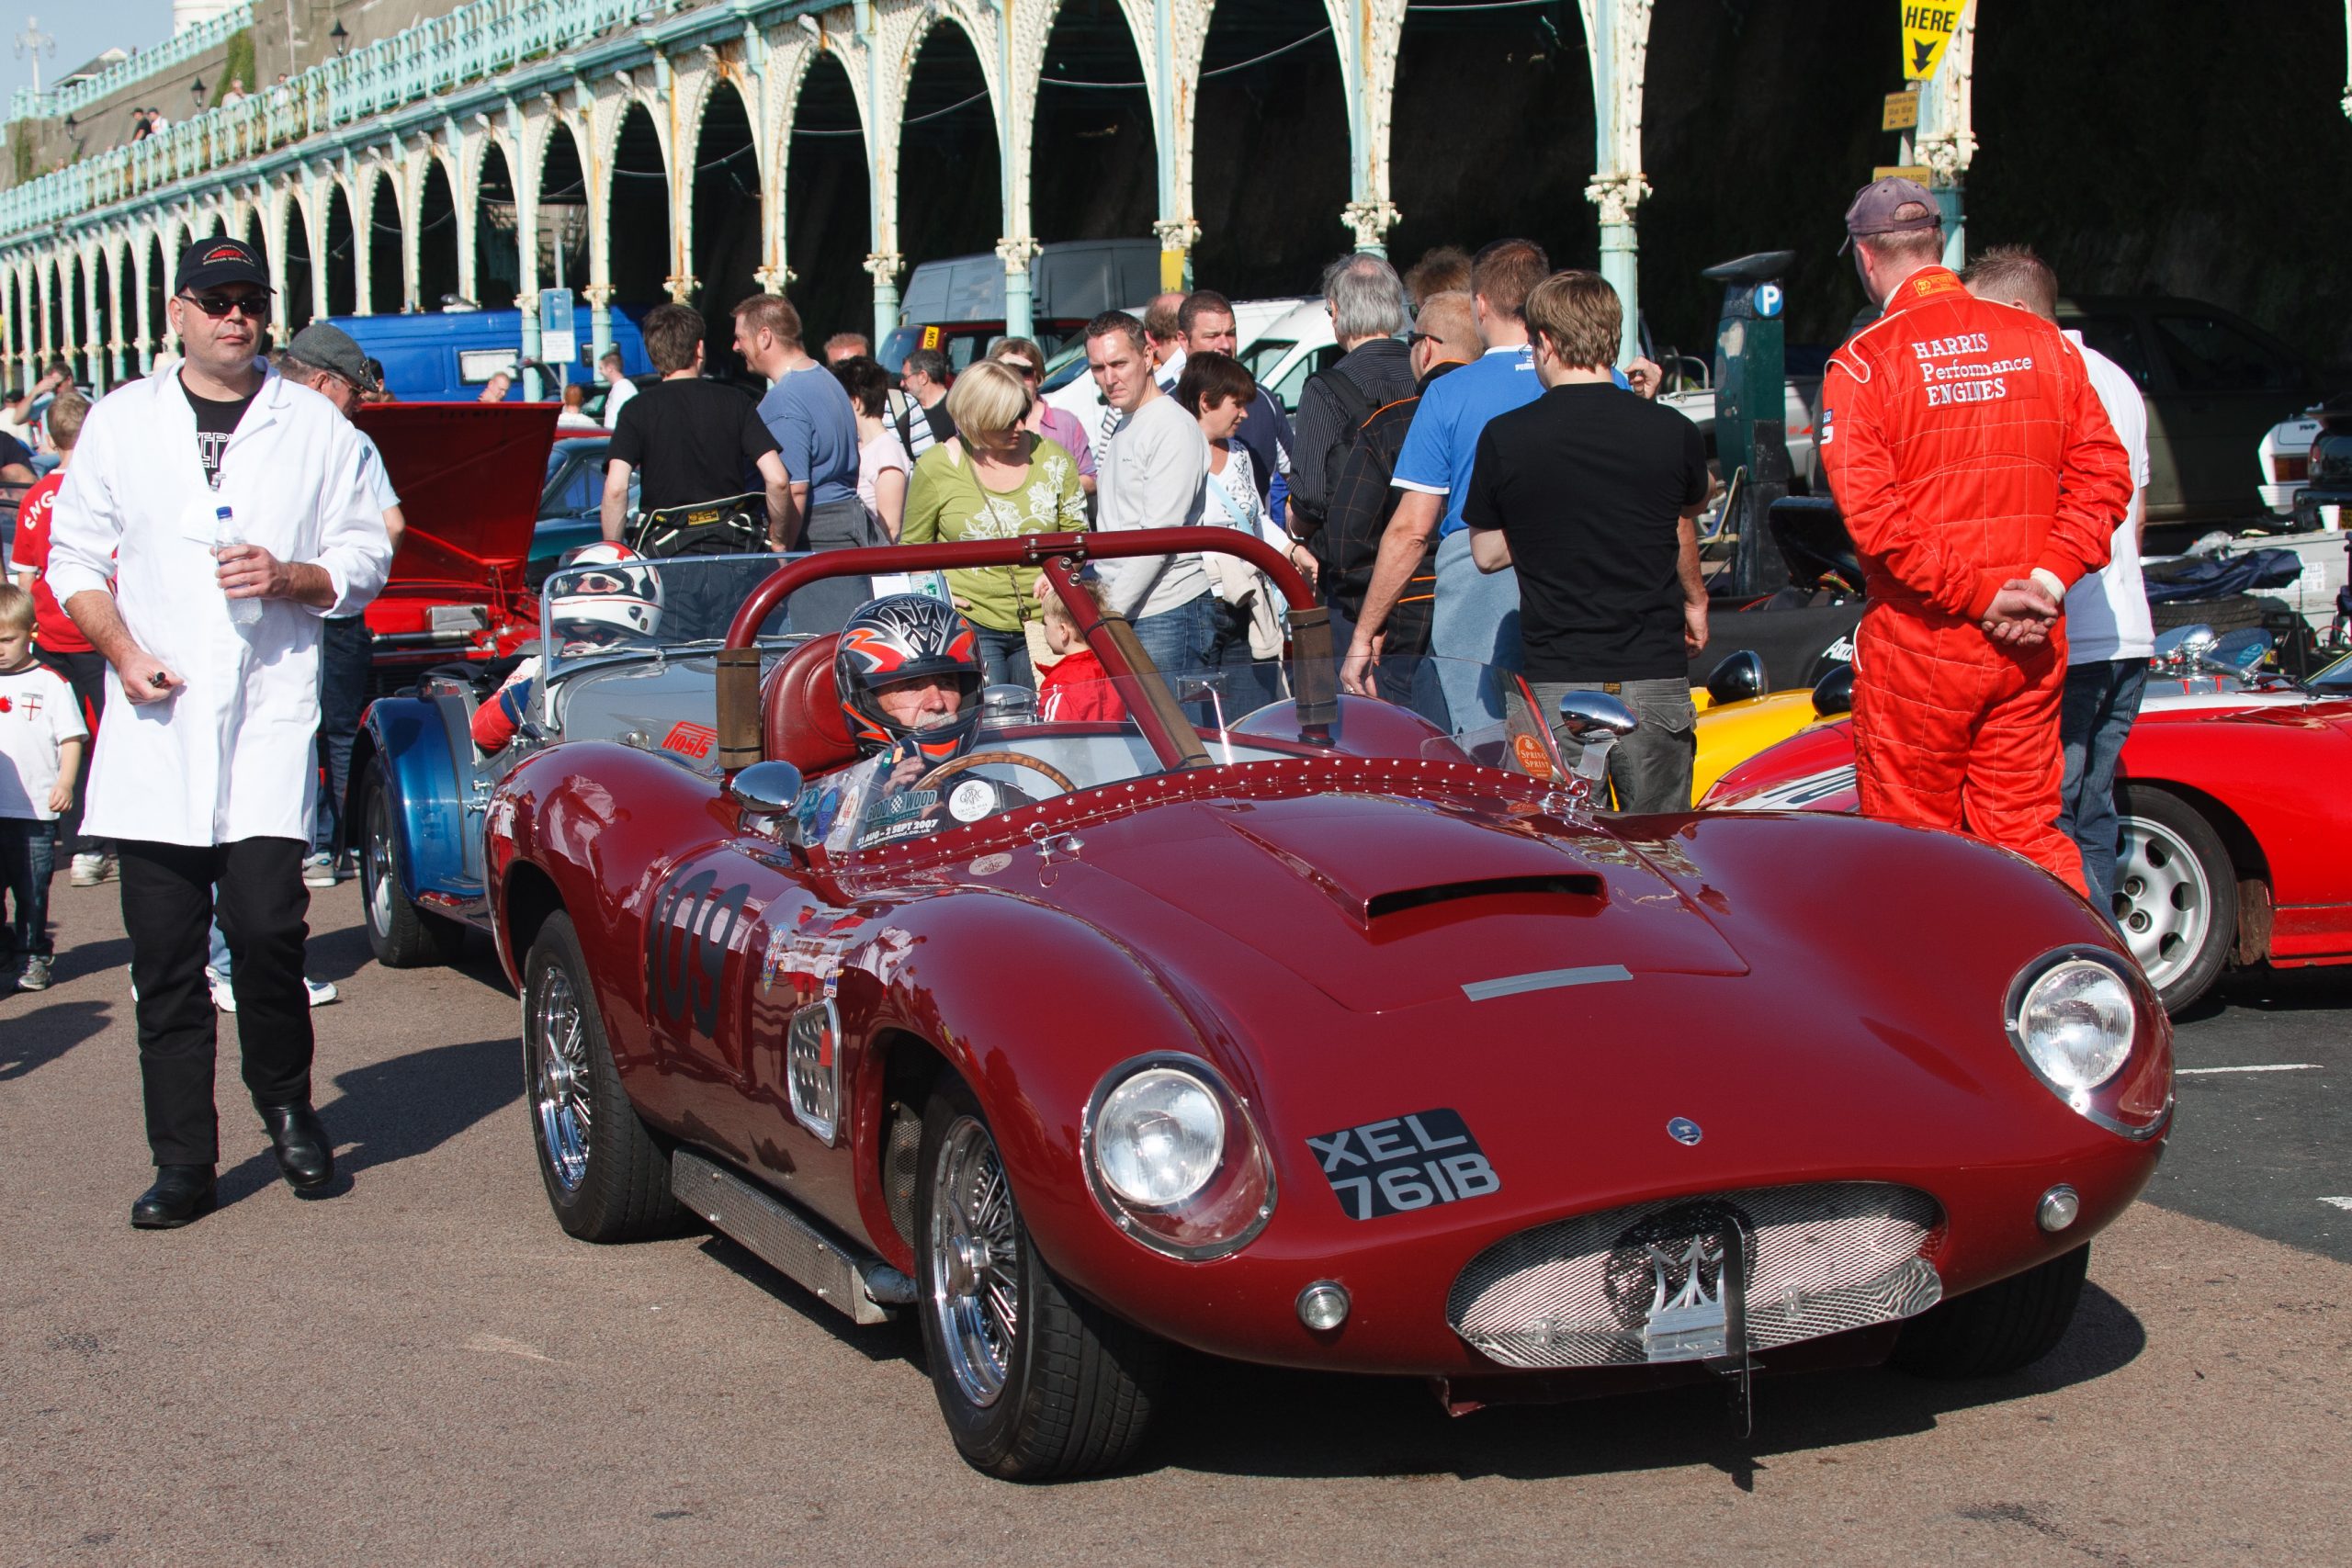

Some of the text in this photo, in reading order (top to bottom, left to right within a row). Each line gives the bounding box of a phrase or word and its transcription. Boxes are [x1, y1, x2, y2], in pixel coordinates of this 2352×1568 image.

[1905, 6, 1955, 33] HERE
[1762, 285, 1780, 314] P
[1911, 333, 1989, 359] HARRIS
[1926, 378, 2007, 407] ENGINES
[867, 791, 935, 820] GOOD WOOD
[865, 830, 880, 843] AUG
[892, 822, 912, 834] SEPT
[912, 818, 939, 829] 2007
[647, 862, 751, 1039] 109
[1306, 1114, 1468, 1173] XEL
[1330, 1153, 1500, 1221] 761B
